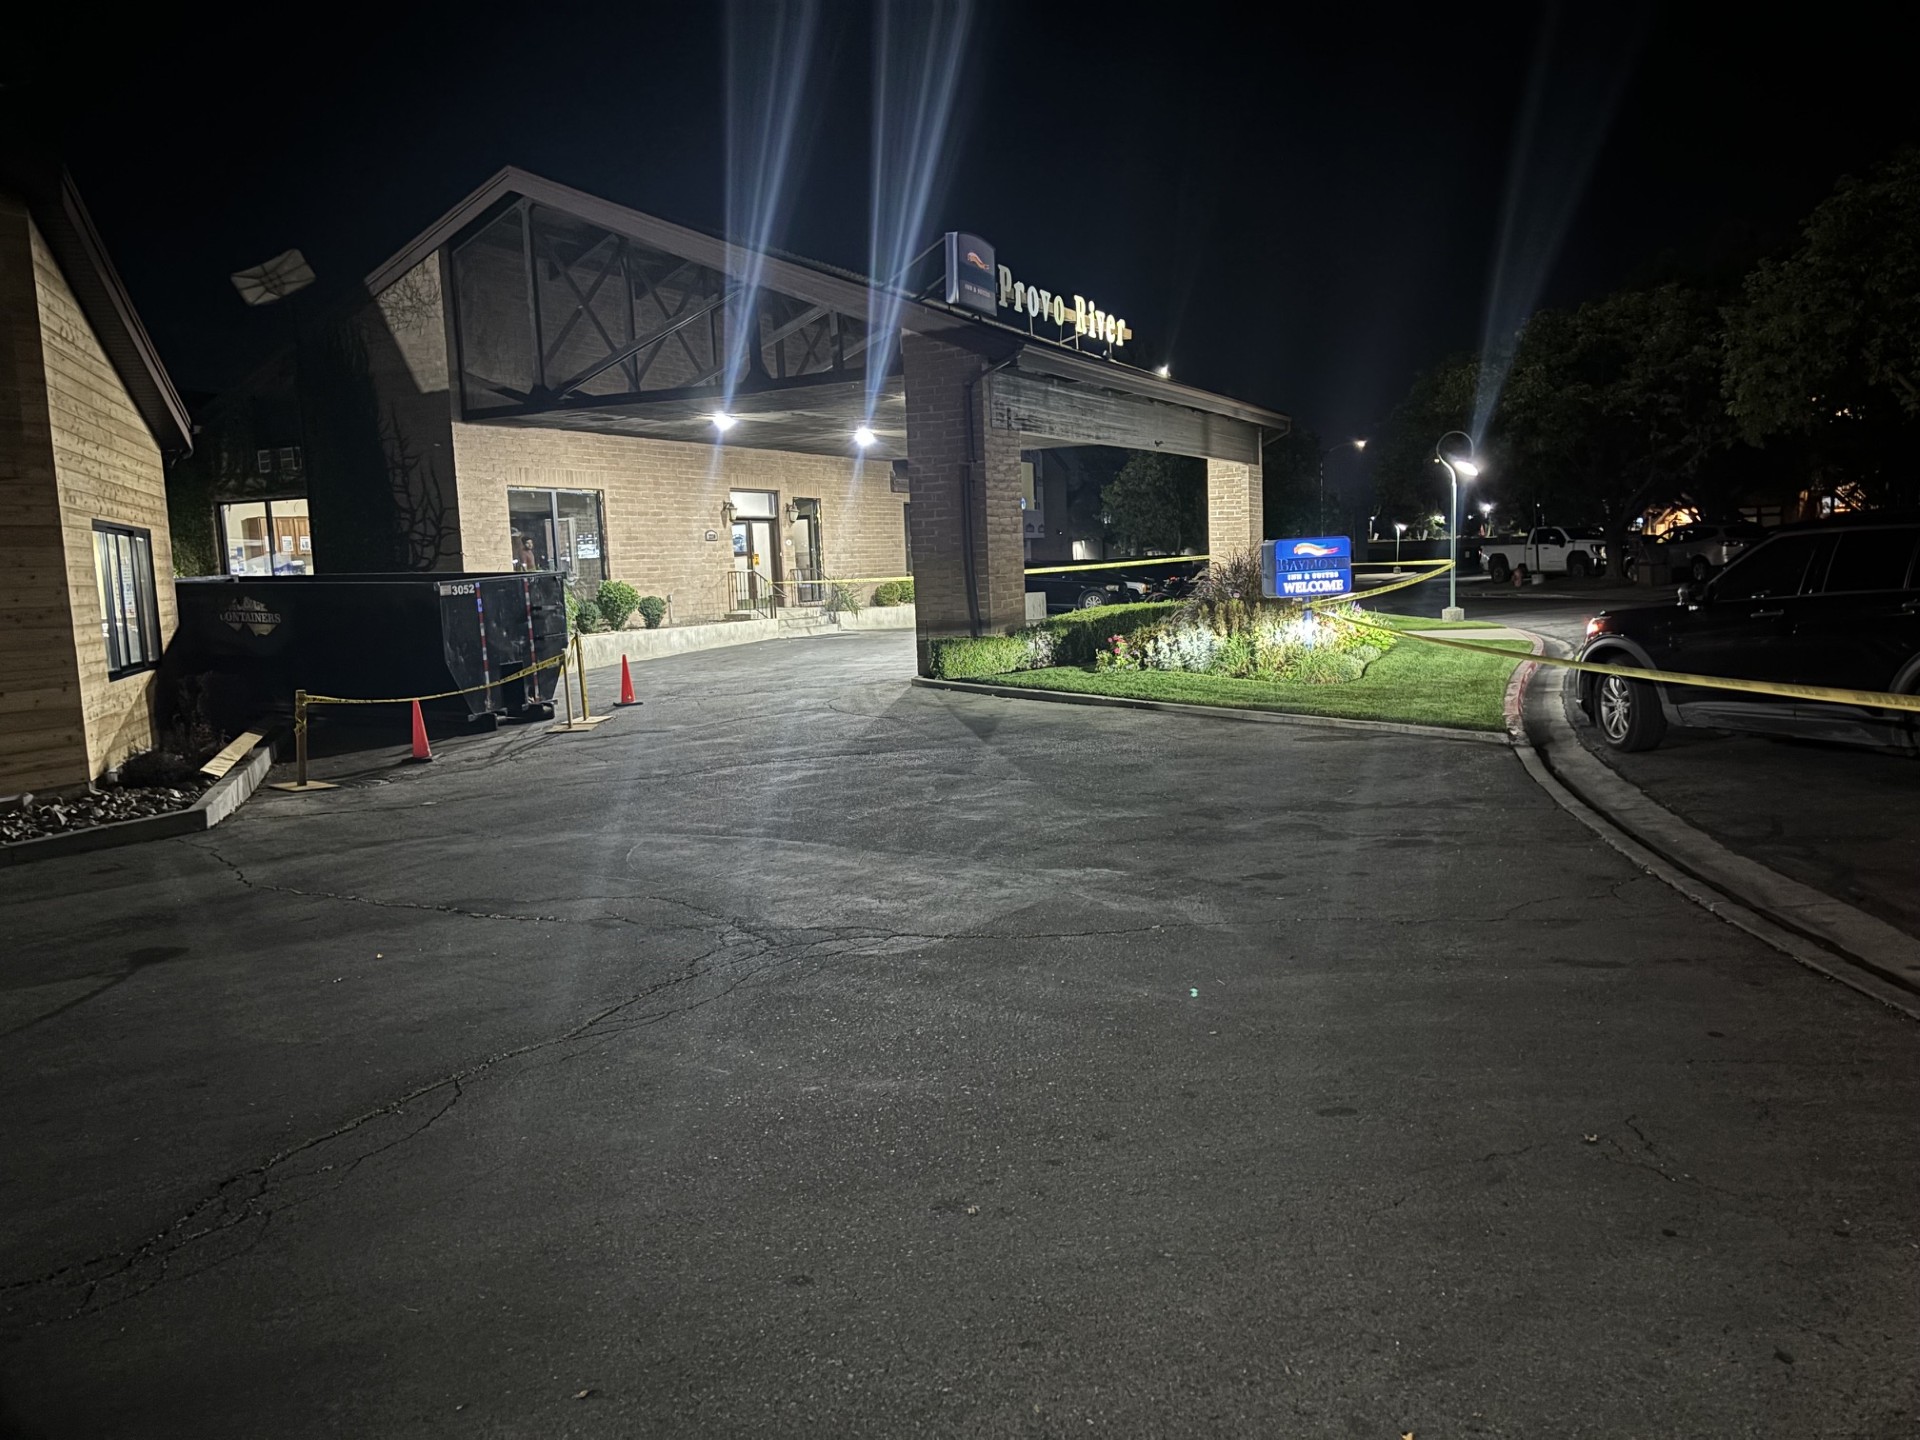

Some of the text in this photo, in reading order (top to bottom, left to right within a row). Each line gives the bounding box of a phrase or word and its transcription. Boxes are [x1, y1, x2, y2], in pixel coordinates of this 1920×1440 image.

[998, 264, 1126, 346] Provo River
[452, 584, 475, 595] 3052
[1283, 580, 1344, 593] WELCOME
